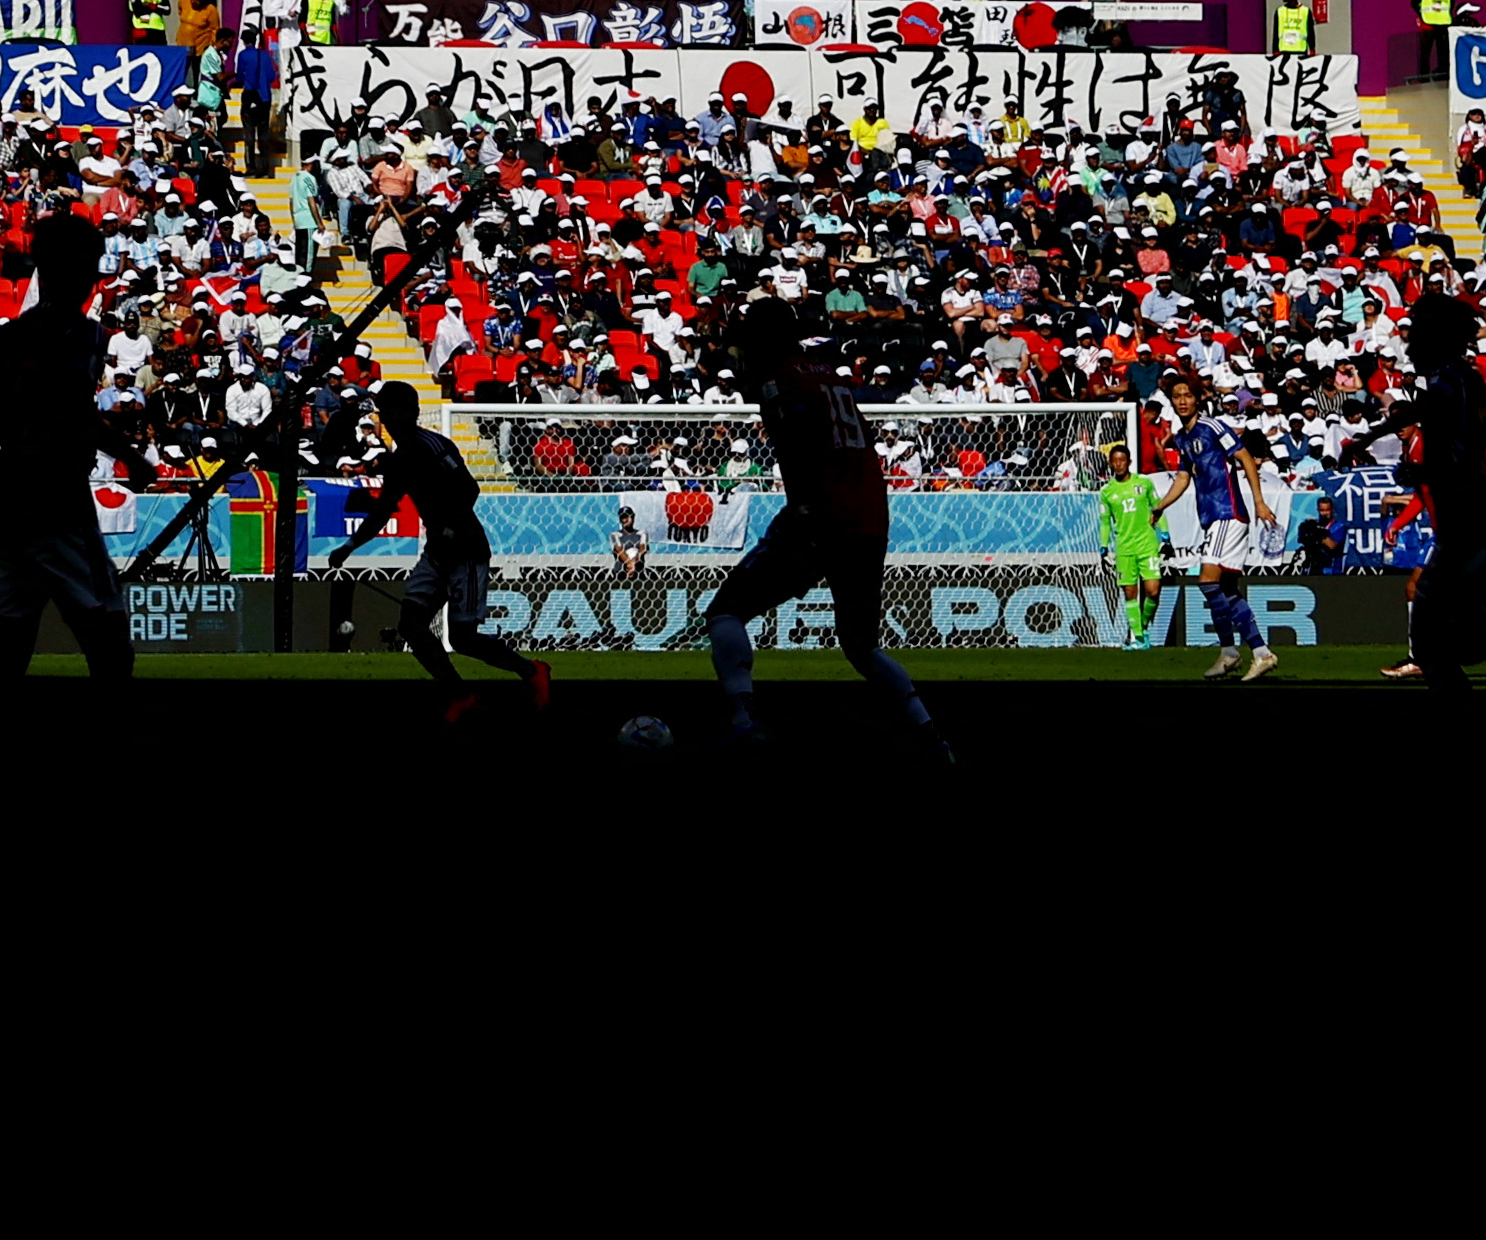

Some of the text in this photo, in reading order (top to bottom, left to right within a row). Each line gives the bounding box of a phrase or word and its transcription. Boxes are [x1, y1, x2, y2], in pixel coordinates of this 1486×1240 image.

[820, 383, 867, 449] 19
[1121, 498, 1136, 514] 12
[128, 584, 236, 612] POWER
[129, 613, 189, 641] ADE
